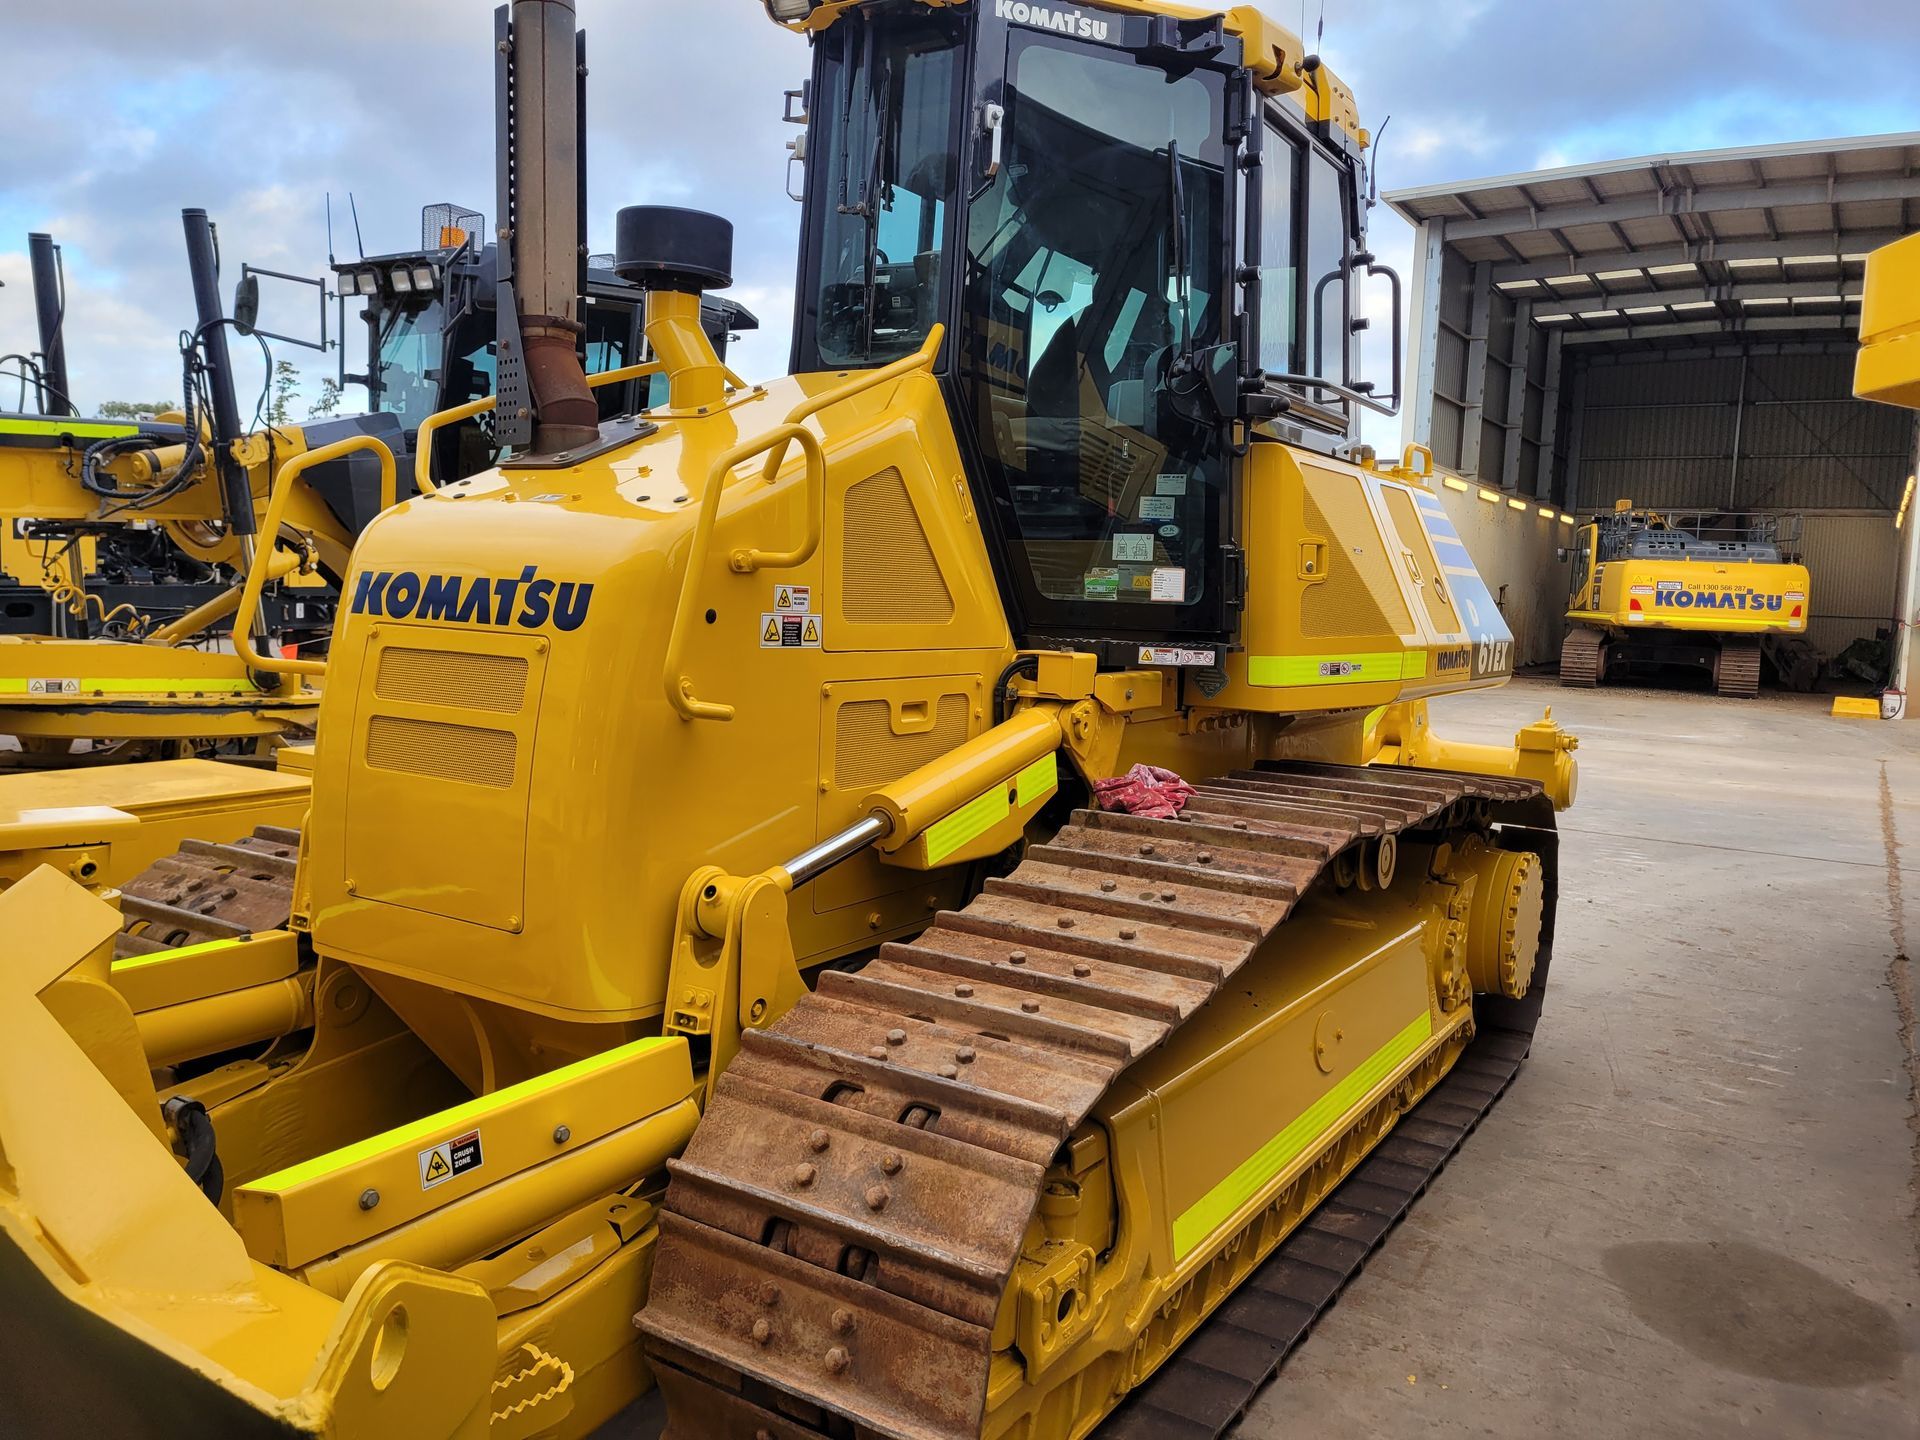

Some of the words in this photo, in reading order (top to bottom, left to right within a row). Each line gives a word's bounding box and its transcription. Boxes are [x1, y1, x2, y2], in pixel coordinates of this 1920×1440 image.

[995, 0, 1107, 40] KOMATSU
[351, 565, 594, 632] KOMATSU
[1655, 588, 1782, 611] KOMATSU
[1437, 645, 1471, 671] KOMATSU
[453, 1146, 474, 1160] CRUSH
[454, 1155, 472, 1168] ZONE
